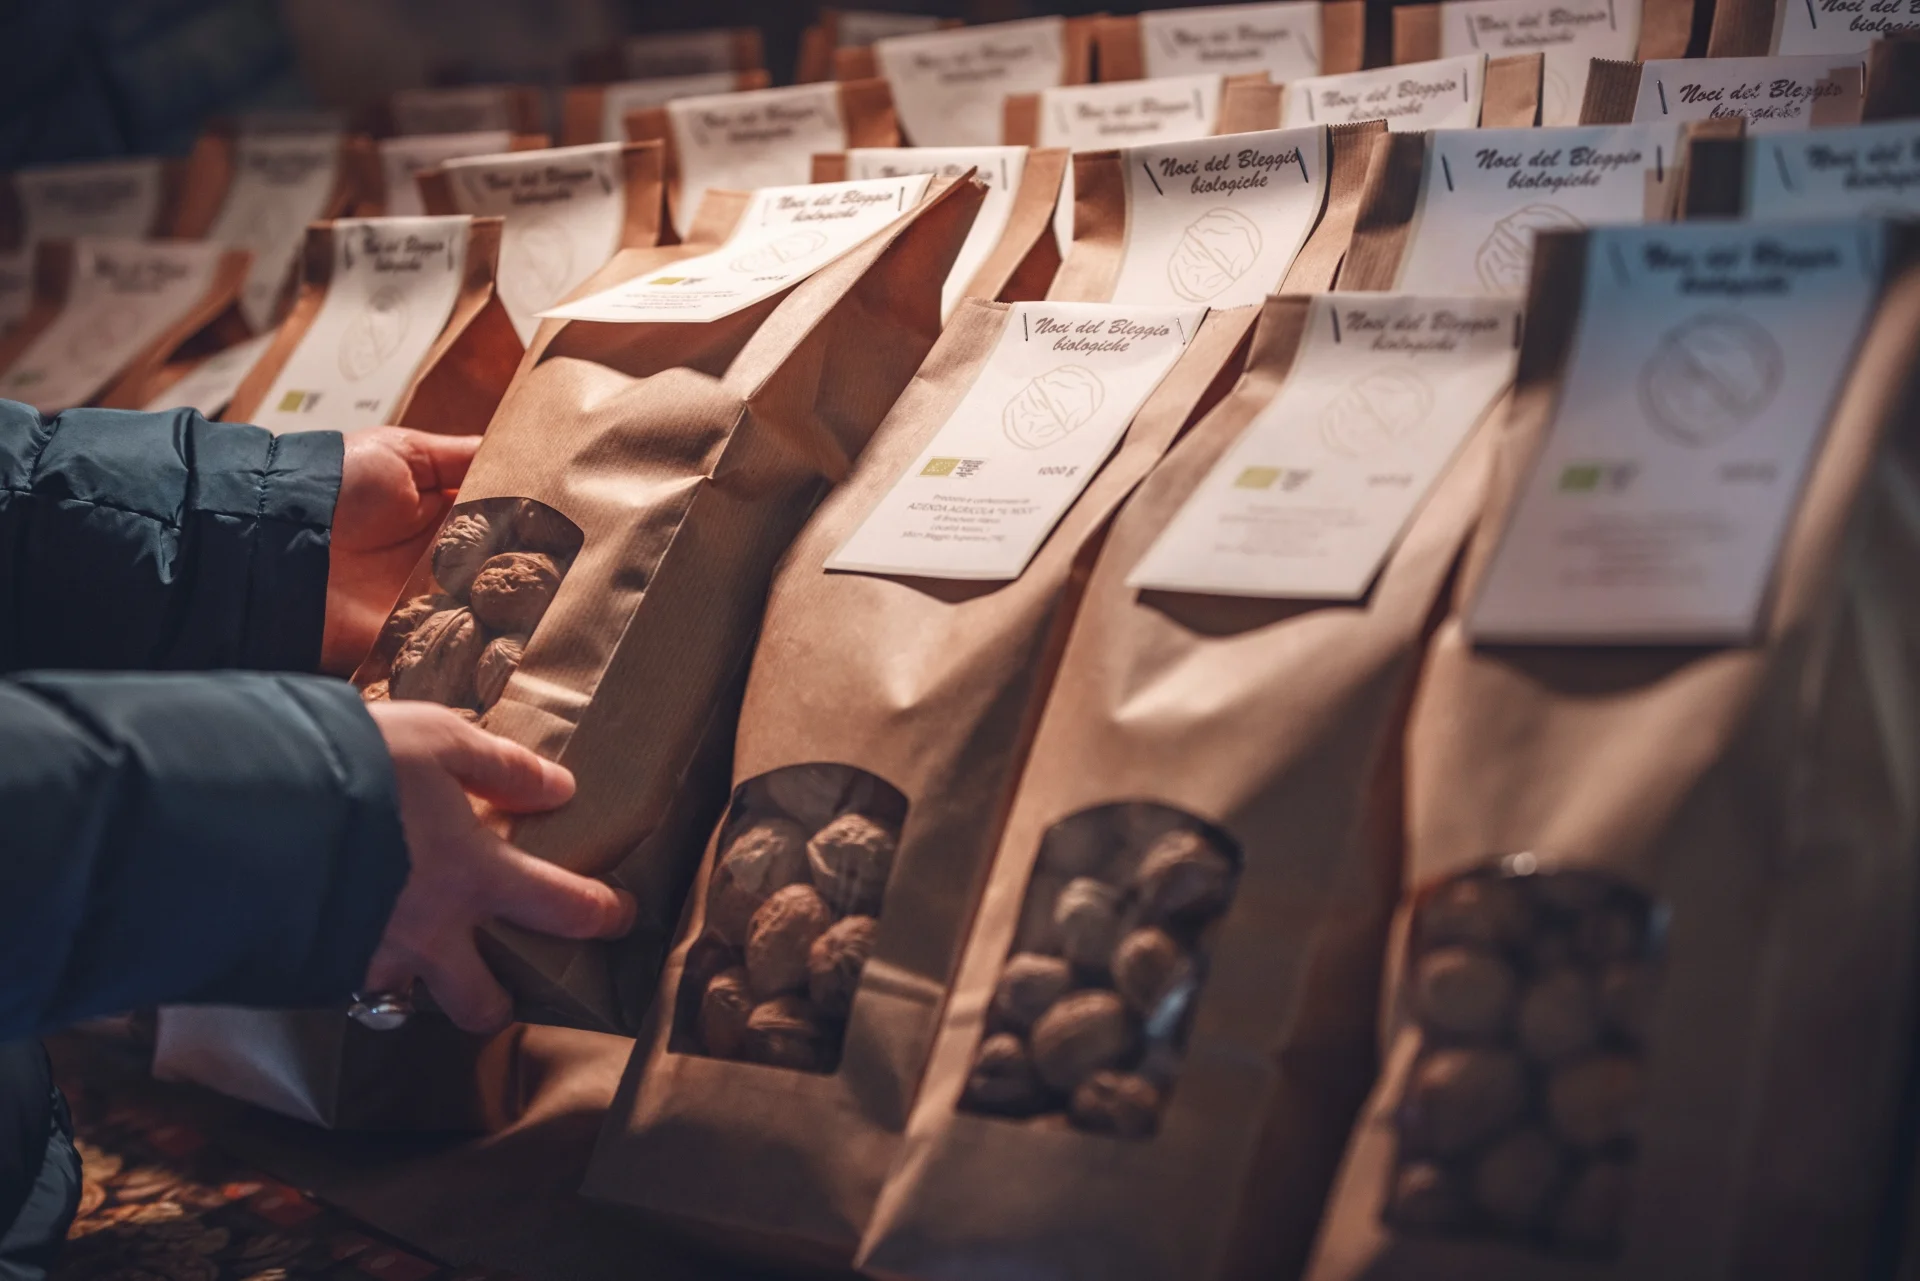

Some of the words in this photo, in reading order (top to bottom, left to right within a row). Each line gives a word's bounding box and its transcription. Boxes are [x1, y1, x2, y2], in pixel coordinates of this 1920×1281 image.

[1870, 0, 1900, 13] del
[1679, 83, 1725, 103] Noci
[1730, 81, 1763, 99] del
[1159, 157, 1199, 177] Noci
[1204, 153, 1231, 172] del
[1237, 149, 1299, 172] Bleggio
[1475, 148, 1522, 169] Noci
[1528, 149, 1562, 167] del
[1569, 146, 1642, 171] Bleggio
[1190, 170, 1269, 196] biologiche
[1507, 169, 1602, 194] biologiche
[1034, 317, 1073, 335] Noci
[1075, 320, 1105, 334] del
[1108, 319, 1170, 340] Bleggio
[1052, 336, 1130, 356] biologiche
